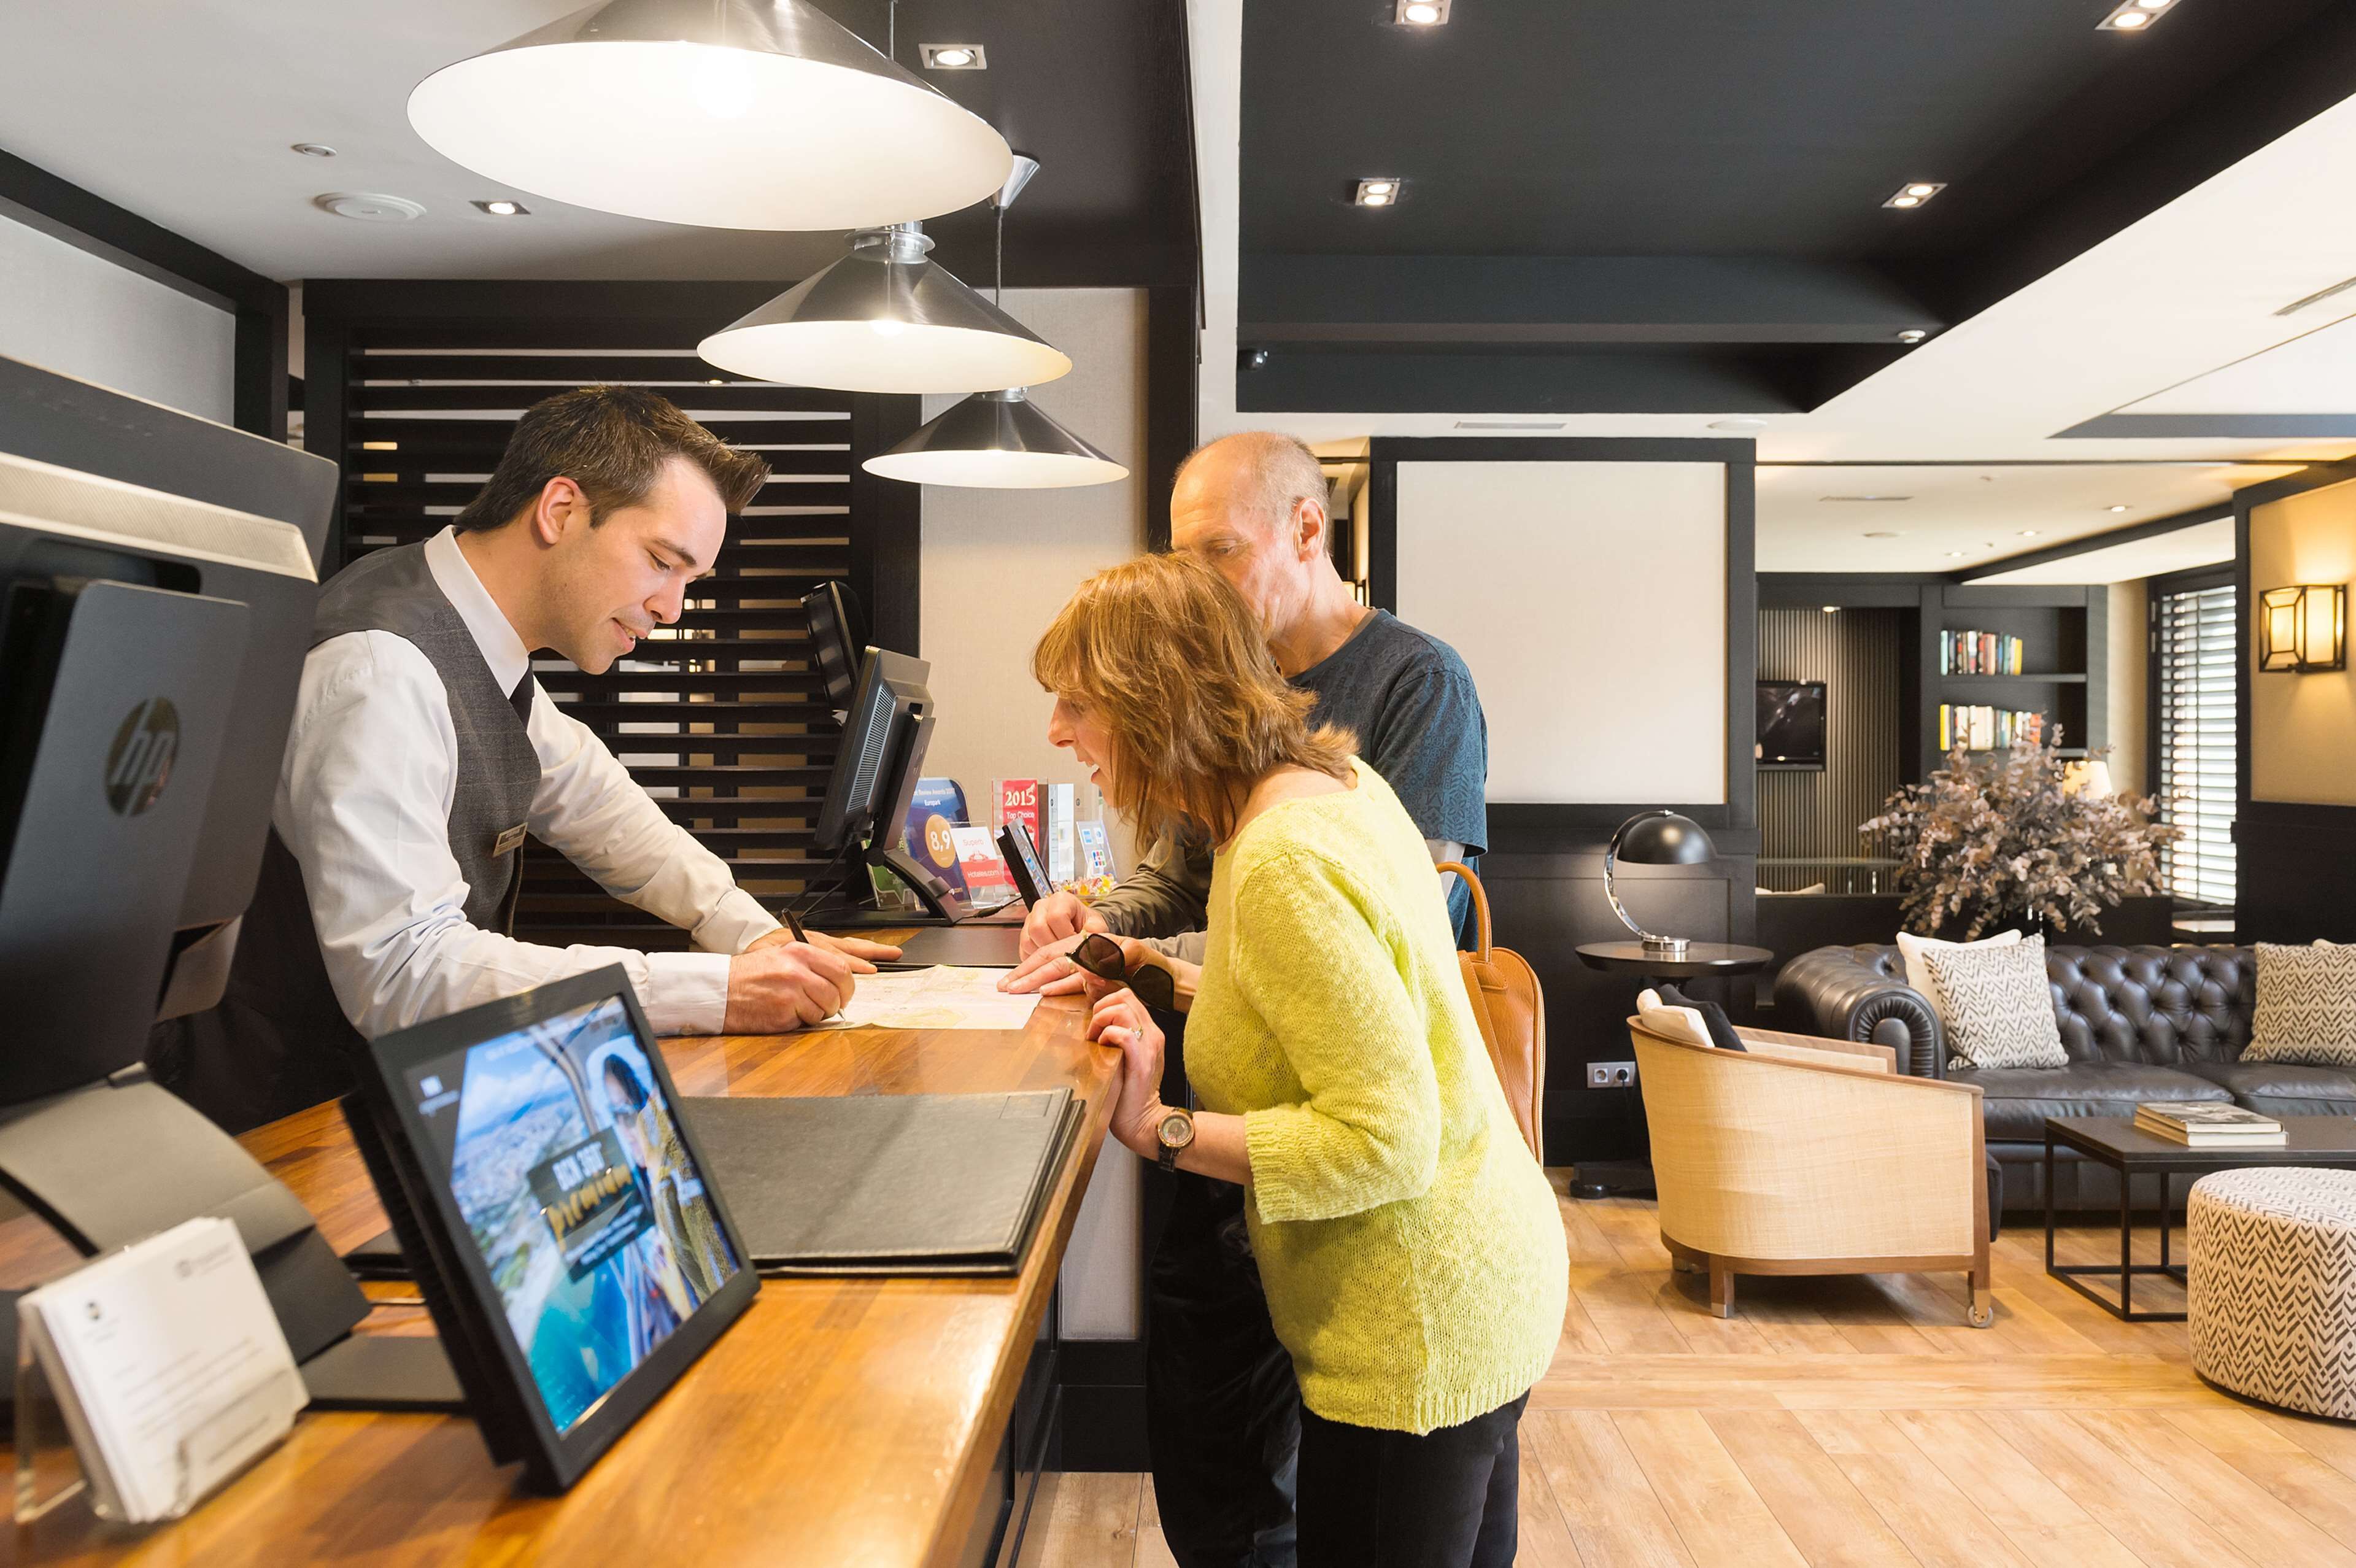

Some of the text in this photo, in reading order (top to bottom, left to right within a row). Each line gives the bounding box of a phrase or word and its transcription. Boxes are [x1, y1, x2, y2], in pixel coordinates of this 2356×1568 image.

[109, 697, 179, 816] hp
[1005, 782, 1036, 806] 2015
[1006, 811, 1035, 821] Top Choice
[930, 830, 951, 852] 8,9
